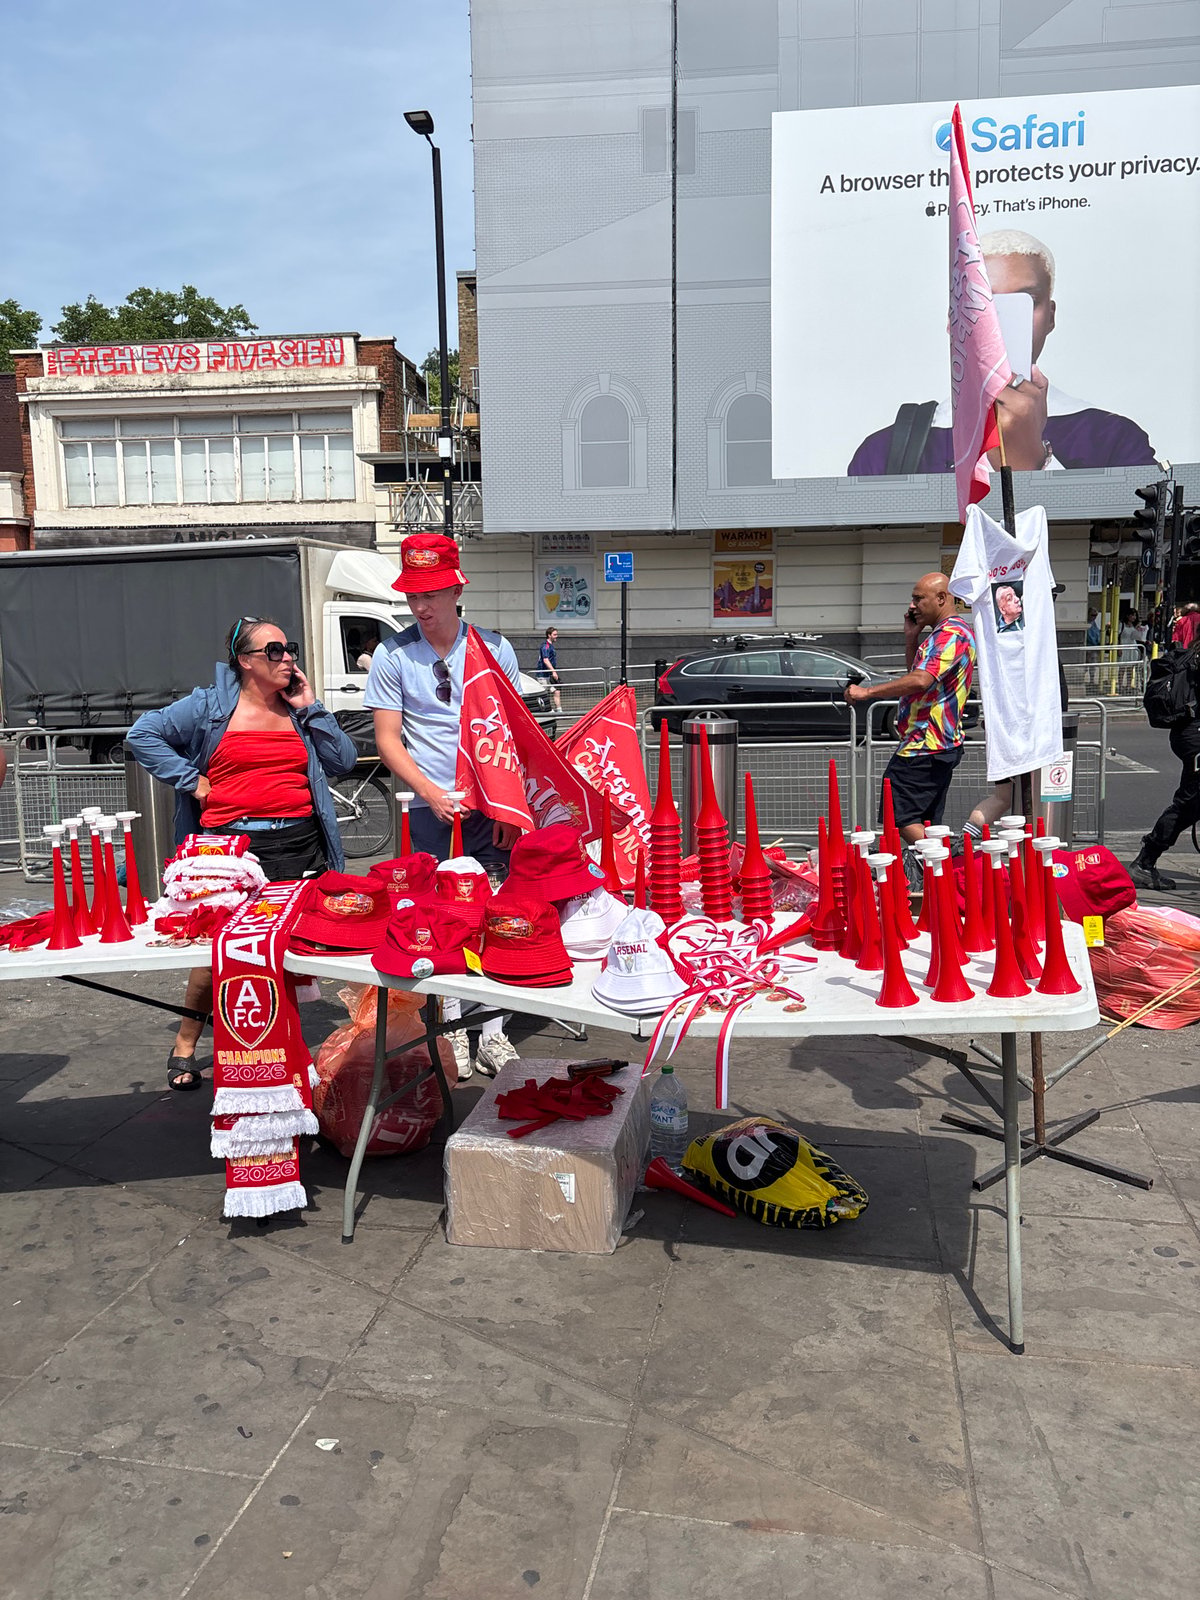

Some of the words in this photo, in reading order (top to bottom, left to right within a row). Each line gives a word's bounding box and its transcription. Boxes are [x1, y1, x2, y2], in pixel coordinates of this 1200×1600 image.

[971, 110, 1085, 152] Safari
[820, 175, 835, 194] A
[840, 173, 925, 193] browser
[929, 168, 970, 187] th
[975, 163, 1064, 188] protects
[1069, 161, 1116, 183] your
[1121, 155, 1200, 179] privacy.
[993, 198, 1035, 213] That's
[1039, 196, 1090, 210] iPhone.
[721, 531, 767, 540] WARMTH
[559, 581, 574, 589] YES
[585, 736, 651, 848] Arsena
[235, 980, 262, 1007] A
[233, 1008, 266, 1028] F.C.
[217, 1048, 286, 1065] CHAMPIONS
[222, 1064, 287, 1081] 2026
[233, 1161, 297, 1182] 2026
